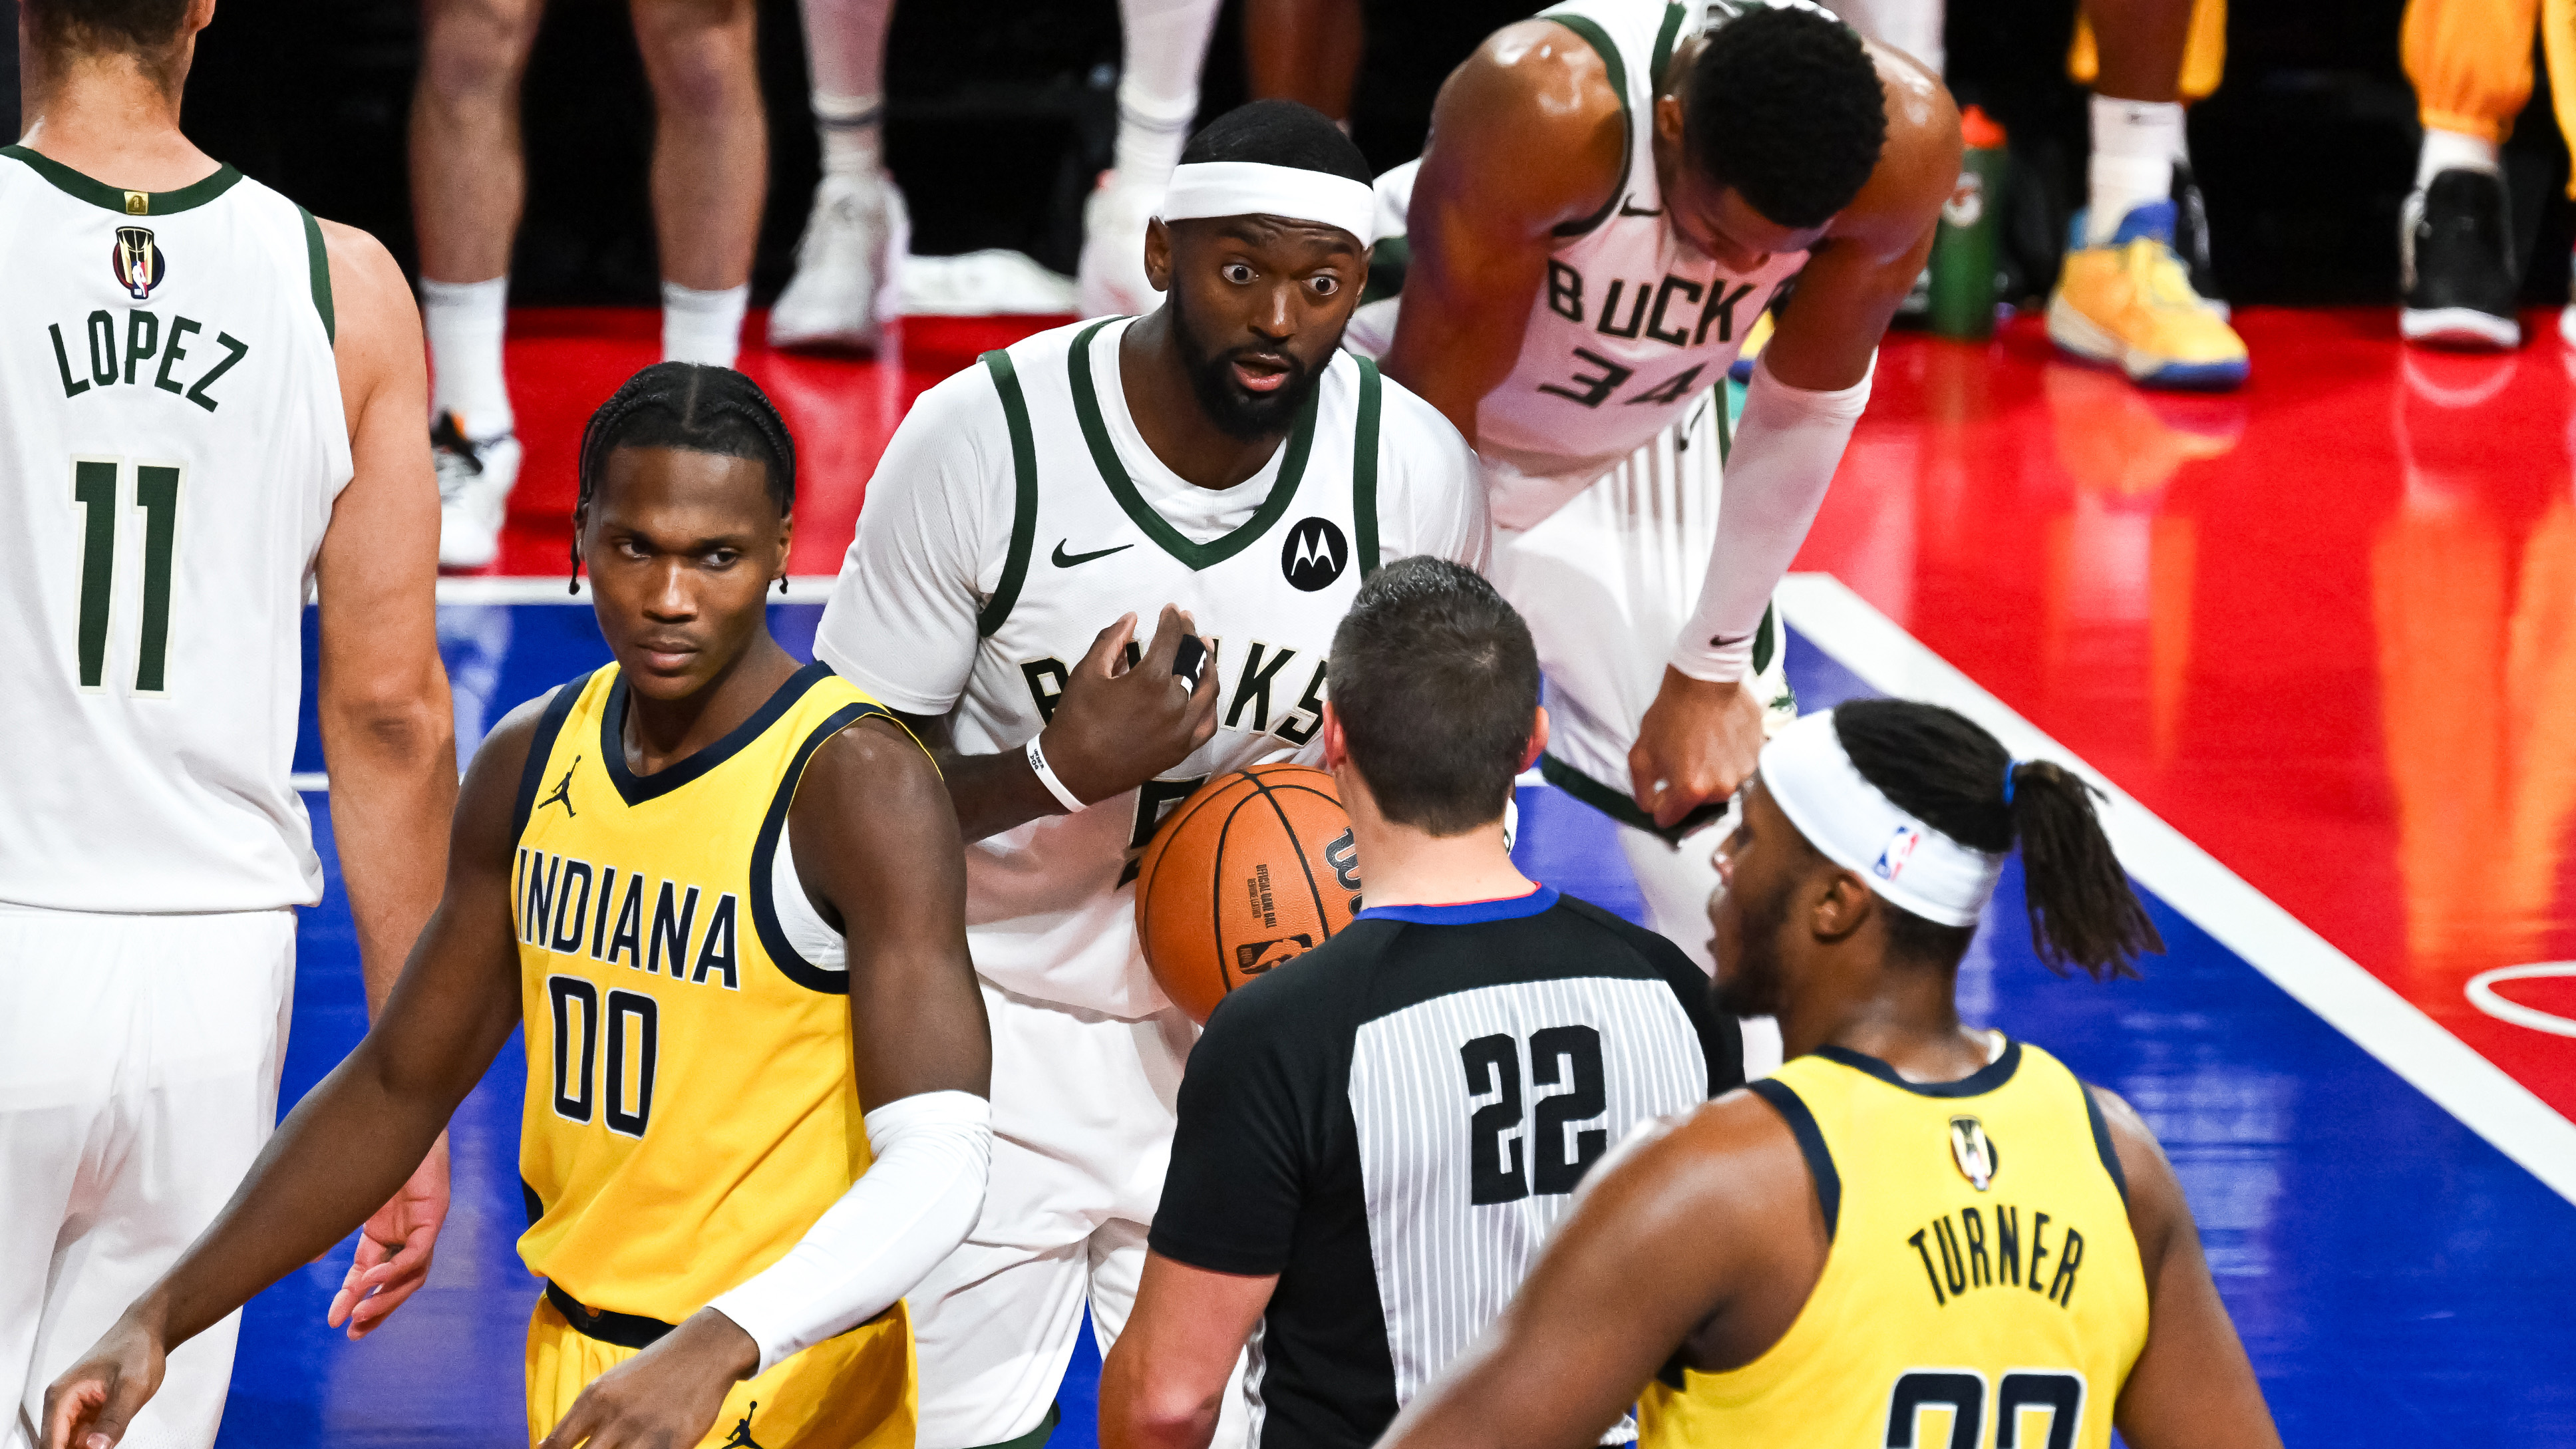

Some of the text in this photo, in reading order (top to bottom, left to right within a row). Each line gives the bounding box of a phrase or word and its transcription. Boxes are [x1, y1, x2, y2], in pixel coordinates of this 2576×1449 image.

[49, 309, 249, 413] LOPEZ
[1537, 346, 1708, 408] 34
[70, 454, 188, 698] 11
[1019, 635, 1329, 747] BKS
[517, 845, 740, 991] INDIANA
[1256, 864, 1277, 929] OFFICIAL GAME BALL
[546, 973, 659, 1140] 00
[1460, 1025, 1607, 1206] 22
[1907, 1204, 2084, 1309] TURNER
